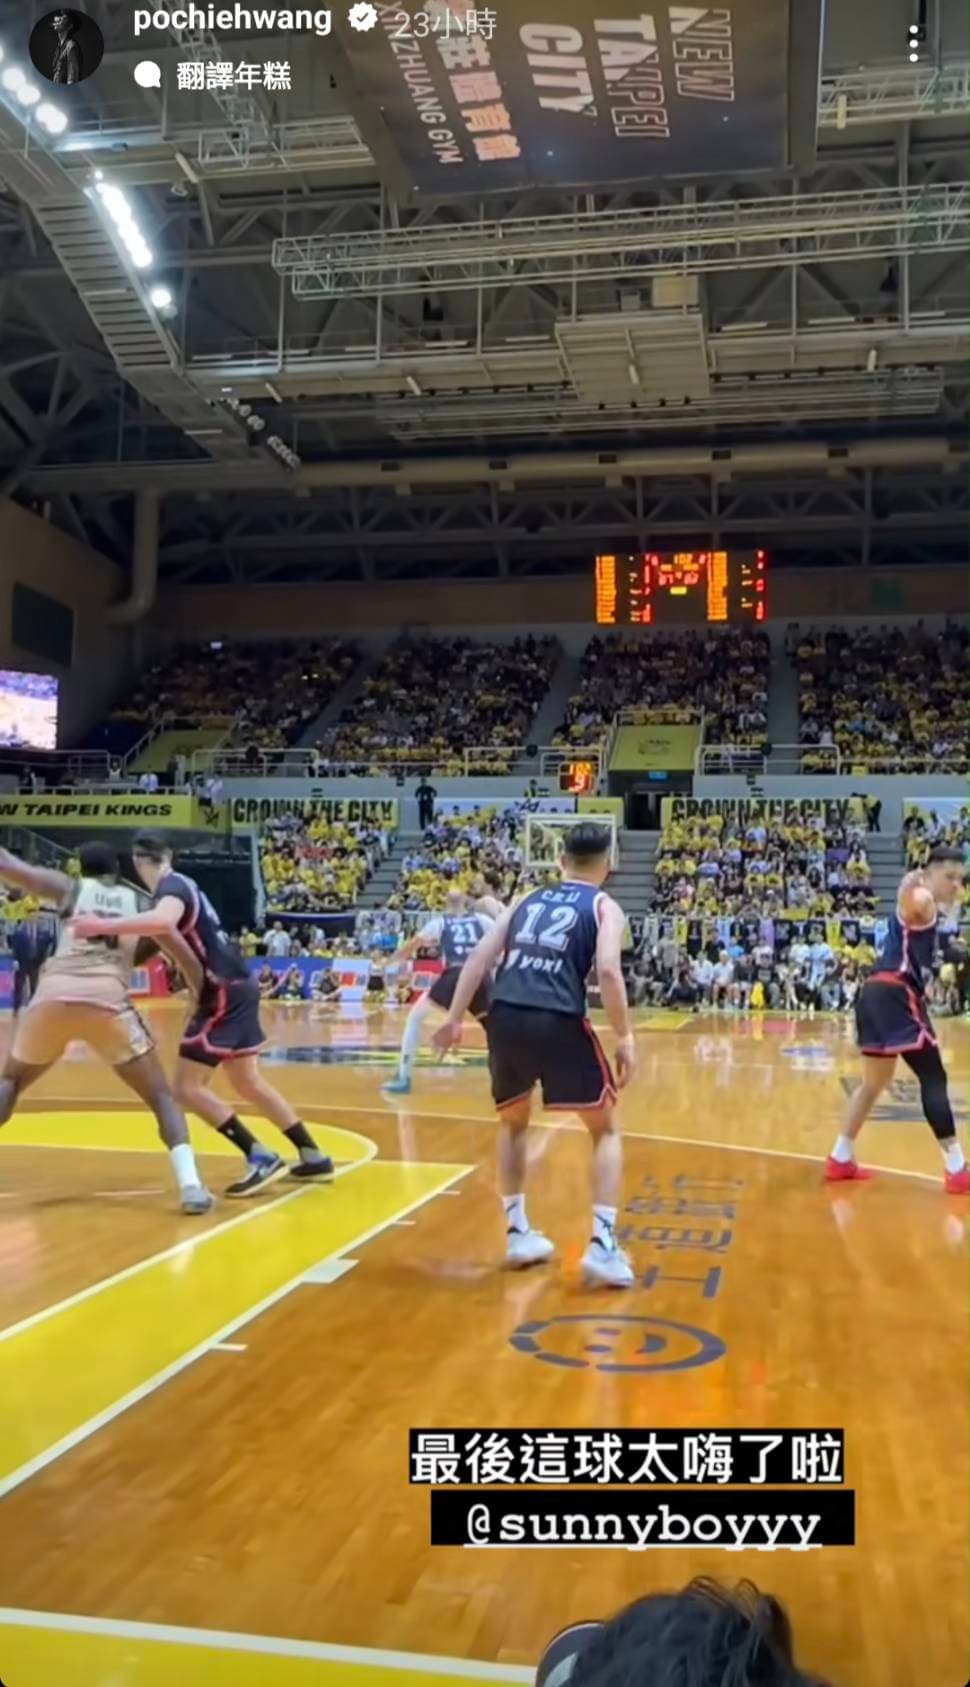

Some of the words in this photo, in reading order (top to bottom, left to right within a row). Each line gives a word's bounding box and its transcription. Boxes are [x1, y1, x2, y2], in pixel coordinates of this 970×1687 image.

[519, 23, 598, 117] CITY
[669, 6, 734, 101] NEW
[594, 13, 670, 138] TAIPEI
[428, 129, 464, 164] GYM
[24, 803, 100, 816] TAIPEI
[105, 803, 173, 816] KINGS
[349, 799, 393, 823] CITY
[450, 922, 477, 943] 21
[515, 902, 579, 952] 12
